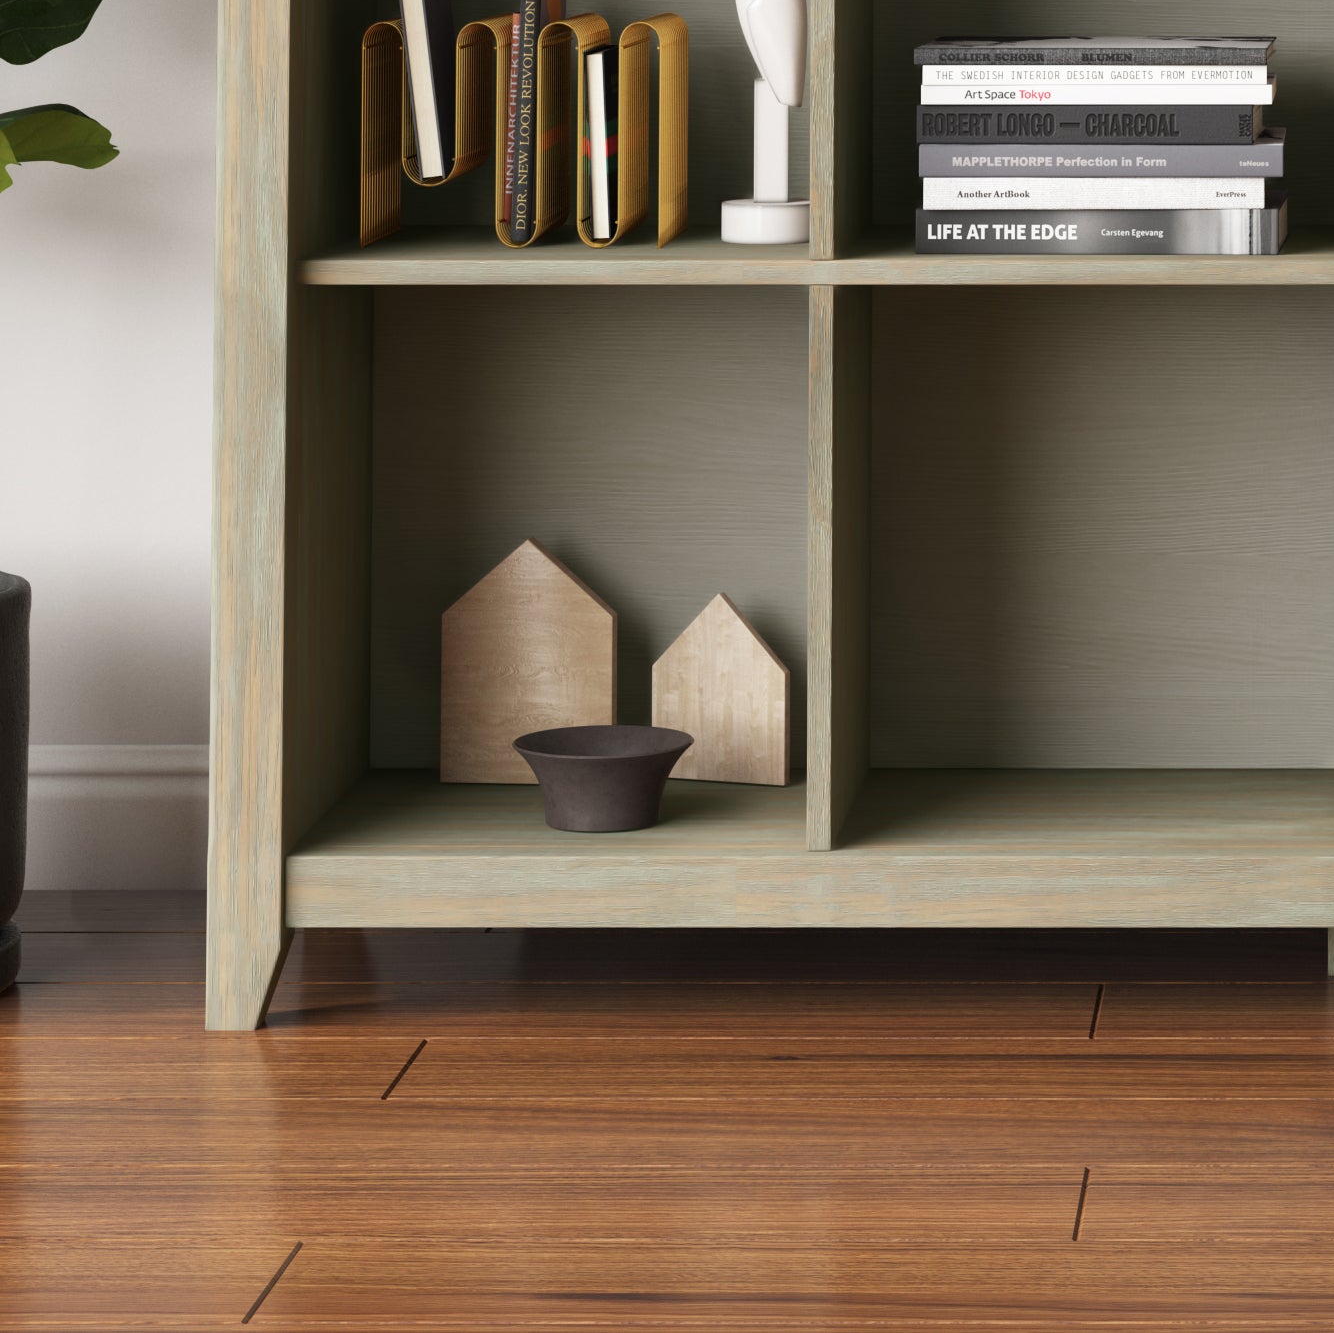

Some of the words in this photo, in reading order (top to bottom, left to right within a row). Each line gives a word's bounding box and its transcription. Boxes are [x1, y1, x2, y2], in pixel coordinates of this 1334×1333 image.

[521, 0, 536, 99] REVOLUTION
[939, 53, 991, 62] COLLIER
[994, 53, 1044, 62] SCHORR
[1081, 53, 1133, 62] BLUMEN
[936, 70, 954, 80] THE
[961, 70, 1004, 80] SWEDISH
[1011, 70, 1060, 80] INTERIOR
[1067, 70, 1104, 80] DESIGN
[1110, 70, 1154, 80] GADGETS
[1160, 70, 1185, 80] FROM
[1191, 70, 1253, 80] EVERMOTION
[964, 90, 983, 99] Art
[985, 90, 1016, 101] Space
[1019, 90, 1051, 101] Tokyo
[505, 24, 521, 194] INNENARCHITEKTUR
[519, 104, 531, 146] LOOK
[921, 113, 992, 138] ROBERT
[996, 113, 1056, 138] LONGO
[1085, 113, 1180, 138] CHARCOAL
[517, 150, 529, 185] NEW
[952, 157, 1053, 167] MAPPLETHORPE
[1056, 157, 1118, 167] Perfection
[1121, 157, 1133, 167] in
[1136, 157, 1167, 167] Form
[993, 190, 1030, 198] ArtBook
[515, 189, 528, 231] DIOR.
[927, 224, 963, 240] LIFE
[966, 224, 989, 240] AT
[992, 224, 1027, 240] THE
[1030, 224, 1078, 241] EDGE
[1101, 228, 1130, 237] Carsten
[1131, 228, 1164, 239] Egevang
